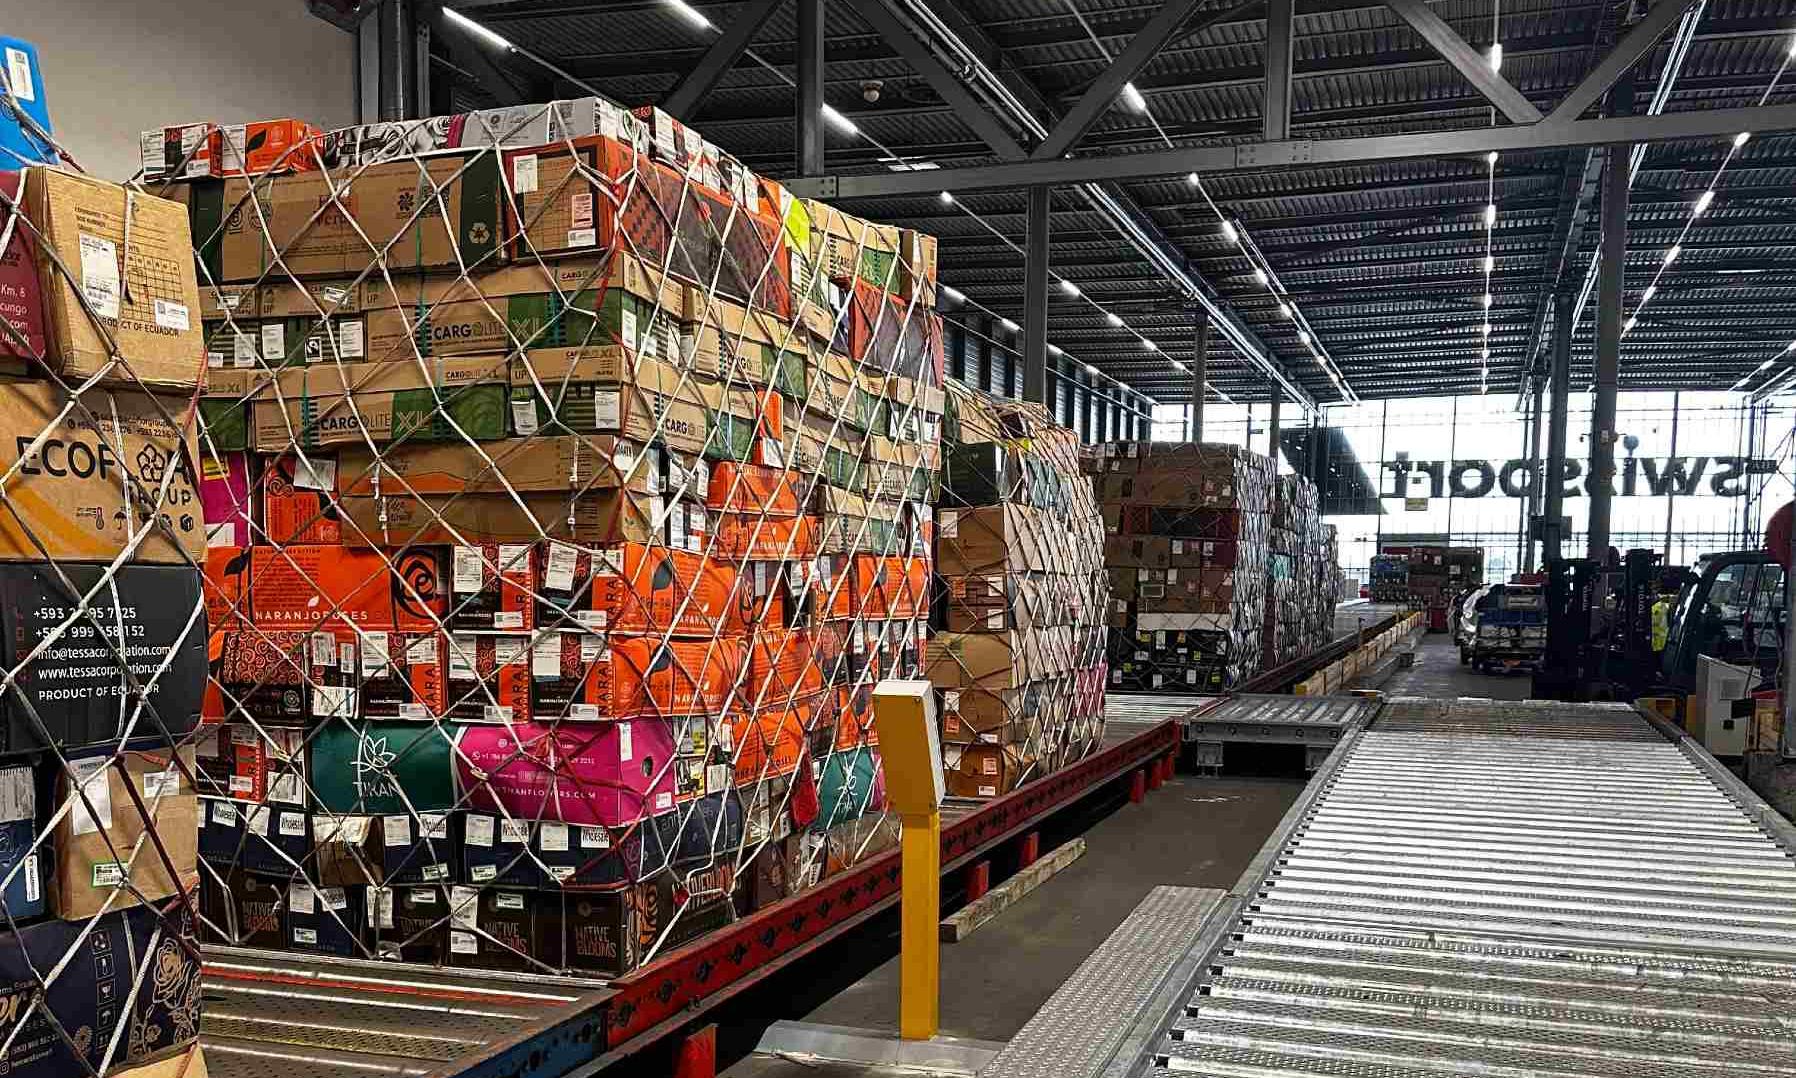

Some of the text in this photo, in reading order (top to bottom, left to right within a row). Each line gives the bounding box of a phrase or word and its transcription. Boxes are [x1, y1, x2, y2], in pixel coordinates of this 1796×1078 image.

[33, 607, 65, 620] +593
[82, 607, 105, 620] 95
[107, 607, 137, 619] 725
[71, 626, 95, 638] 999
[99, 626, 120, 638] 58
[124, 625, 145, 637] 152
[38, 687, 93, 701] PRODUCT
[95, 686, 109, 697] OF
